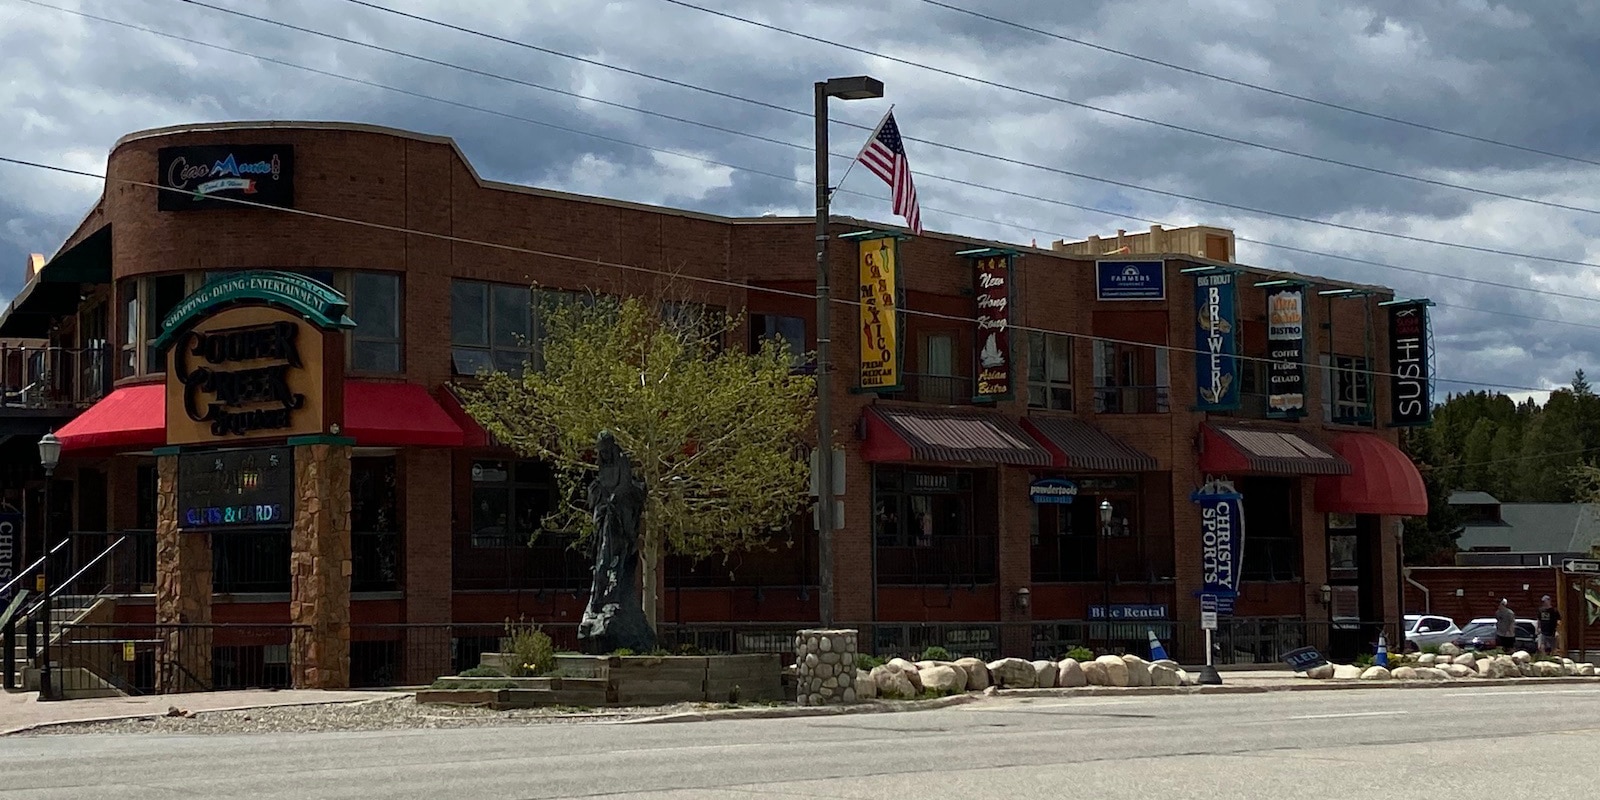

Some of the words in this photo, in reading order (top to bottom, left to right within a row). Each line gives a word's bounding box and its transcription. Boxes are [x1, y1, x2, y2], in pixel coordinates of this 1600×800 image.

[168, 156, 209, 189] Ciao
[864, 253, 893, 307] CASA
[979, 273, 1004, 289] New
[1197, 276, 1209, 287] BIG
[1210, 274, 1231, 285] TROUT
[165, 291, 208, 327] SHOPPING
[212, 279, 245, 296] DINING
[250, 278, 324, 311] ENTERTAINMENT
[977, 294, 1007, 311] Hong
[861, 284, 891, 363] MEXICO
[977, 315, 1007, 332] Kong
[1271, 327, 1300, 335] BISTRO
[1207, 287, 1223, 403] BREWERY
[978, 369, 1006, 381] Asian
[1271, 375, 1300, 384] GELATO
[1397, 338, 1421, 415] SUSHI
[978, 382, 1007, 394] Bistro
[1202, 508, 1217, 584] SPORTS
[1216, 502, 1231, 590] CHRISTY
[1092, 606, 1120, 618] Bie
[1124, 606, 1165, 618] Rental
